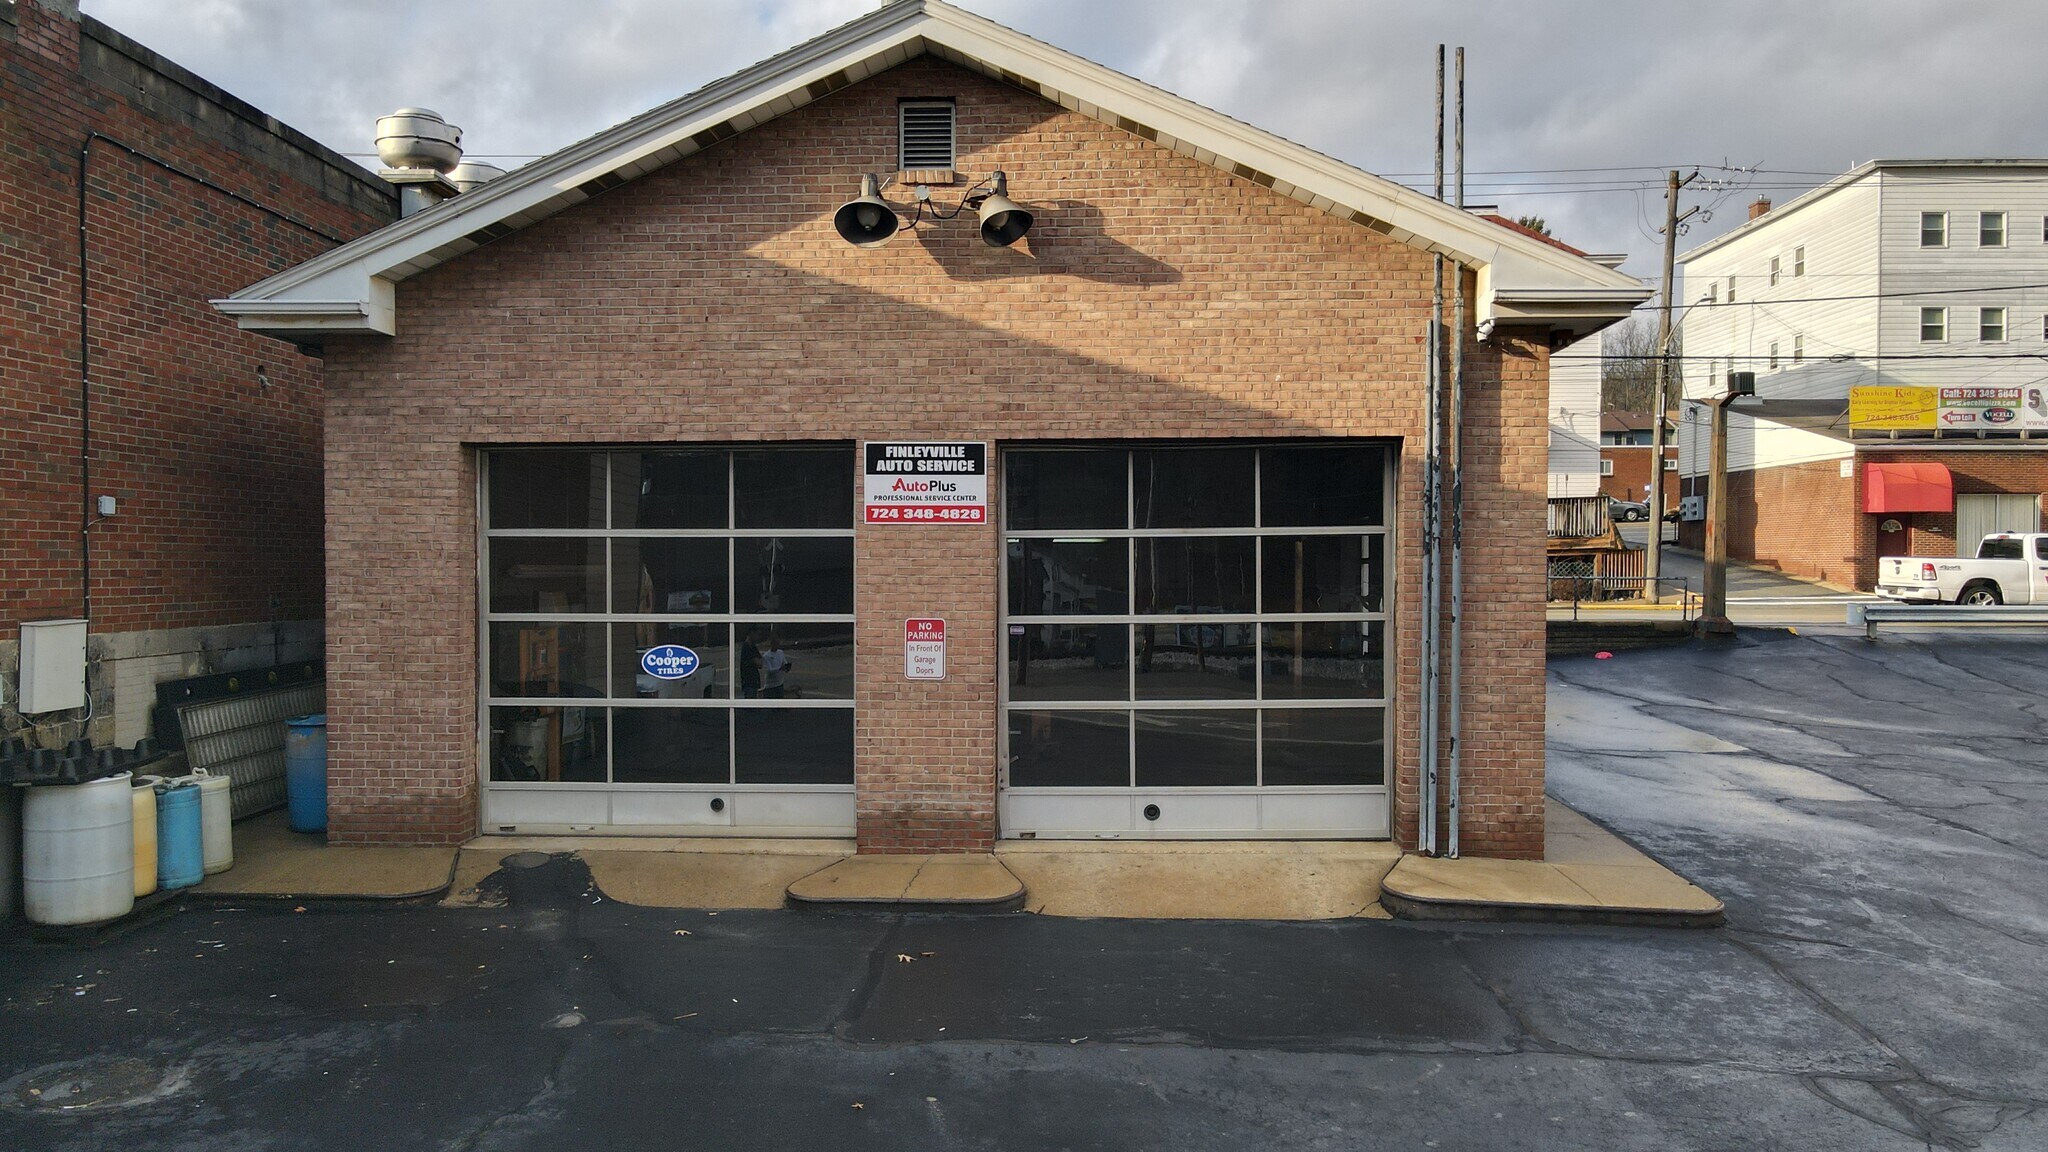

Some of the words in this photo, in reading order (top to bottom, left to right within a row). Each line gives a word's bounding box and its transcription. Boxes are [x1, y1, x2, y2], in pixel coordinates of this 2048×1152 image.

[1852, 388, 1892, 398] Sunshine
[1895, 388, 1916, 398] Kids
[1943, 389, 1961, 398] Call:
[1963, 389, 1976, 398] 724
[885, 446, 965, 458] FINLEYVILLE
[876, 460, 913, 472] AUTO
[917, 460, 975, 472] SERVICE
[892, 477, 957, 492] AutoPlus
[871, 508, 899, 519] 724
[903, 508, 981, 519] 348-4828
[918, 622, 932, 630] NO
[907, 631, 943, 640] PARKING
[646, 654, 694, 668] Cooper
[914, 655, 936, 664] Garage
[915, 666, 934, 674] Doors
